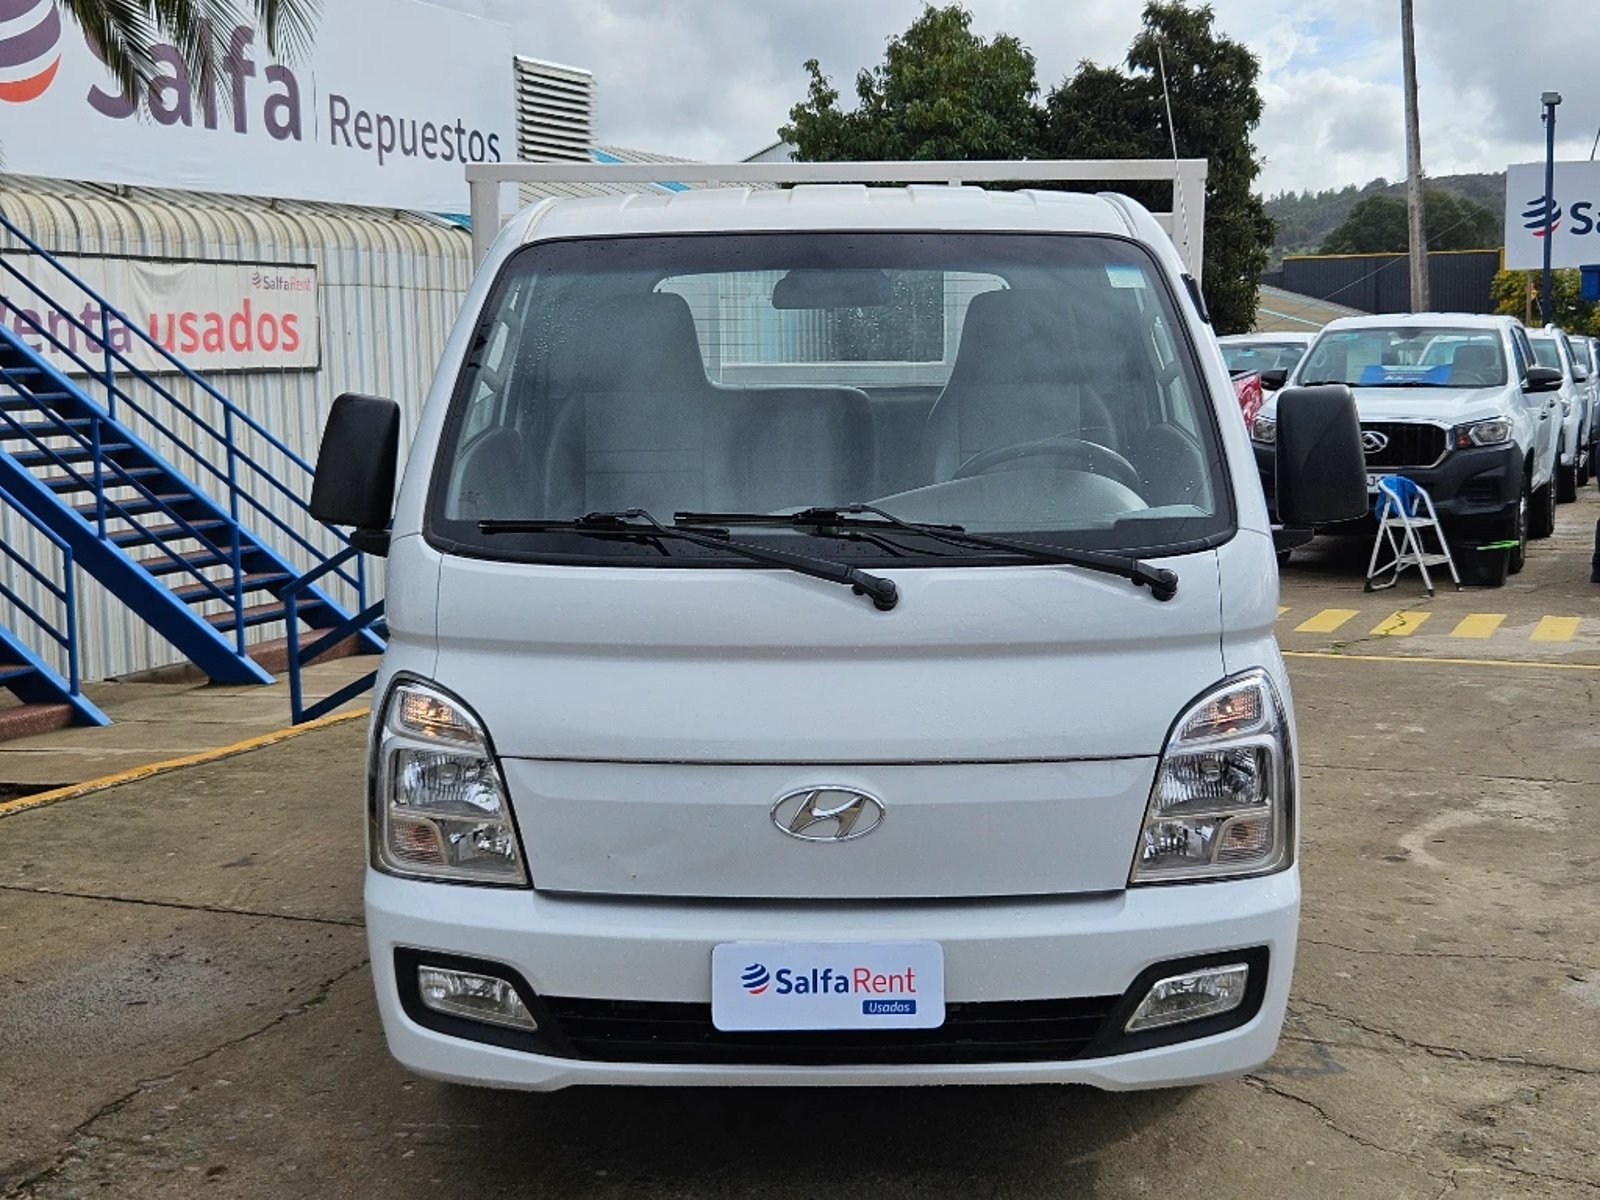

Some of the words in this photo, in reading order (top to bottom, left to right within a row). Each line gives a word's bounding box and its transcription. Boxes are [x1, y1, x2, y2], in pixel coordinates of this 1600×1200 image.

[329, 93, 500, 166] Repuestos
[1569, 201, 1600, 235] S
[0, 301, 132, 354] enta
[150, 298, 299, 353] usados
[775, 967, 917, 995] SalfaRent
[868, 1001, 911, 1013] Usados
